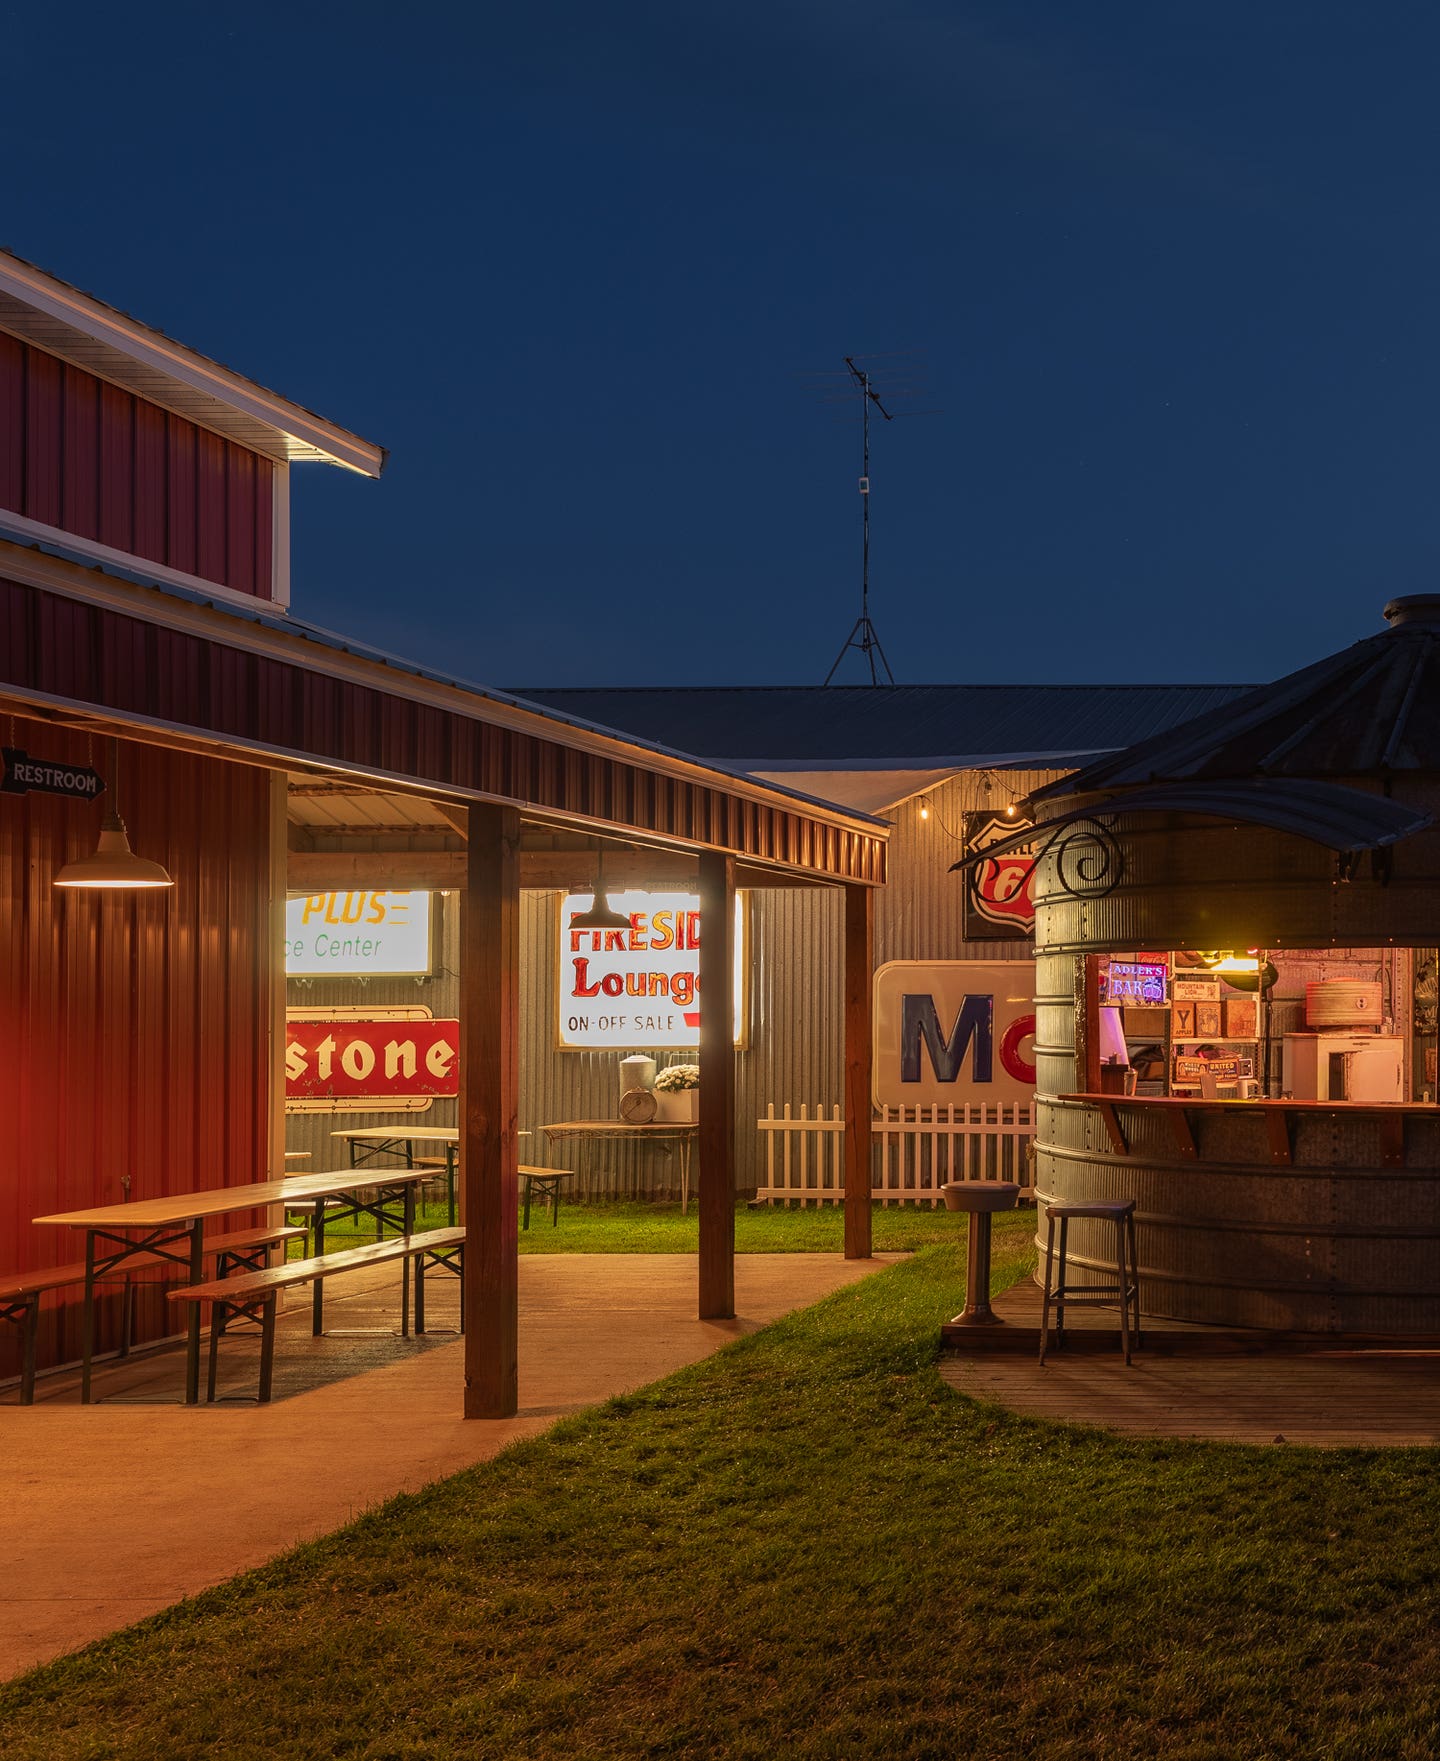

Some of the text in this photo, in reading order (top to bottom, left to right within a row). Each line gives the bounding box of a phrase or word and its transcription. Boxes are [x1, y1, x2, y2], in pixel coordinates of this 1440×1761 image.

[13, 762, 97, 793] RESTROOM
[301, 890, 387, 925] PLUS
[314, 933, 383, 957] Center
[1114, 965, 1163, 975] ADLER'S
[570, 956, 701, 1006] Loung
[1114, 981, 1143, 995] BAR
[567, 1015, 676, 1032] ON-OFF SALE
[1177, 1010, 1190, 1029] Y
